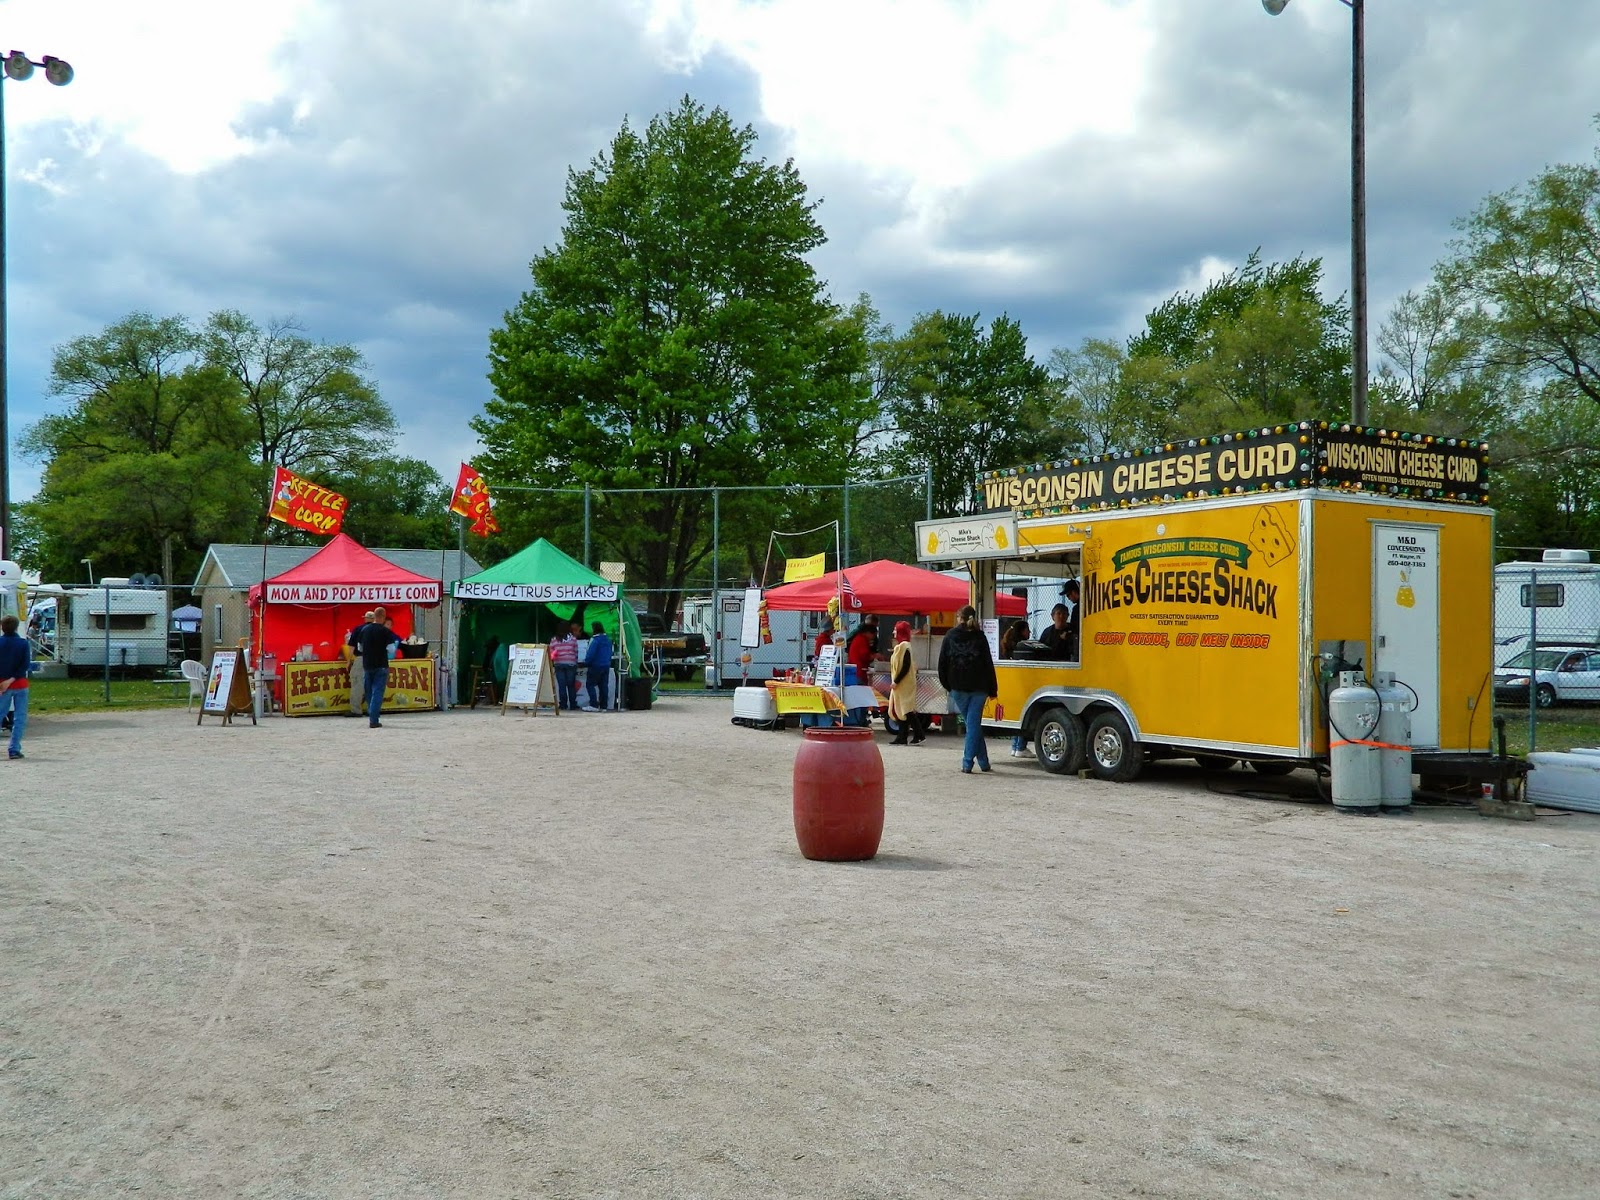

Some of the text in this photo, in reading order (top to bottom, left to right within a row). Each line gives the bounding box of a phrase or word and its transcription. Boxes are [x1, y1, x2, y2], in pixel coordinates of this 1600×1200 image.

[1407, 441, 1427, 449] Original
[1327, 442, 1477, 482] WISCONSIN CHEESE CURD
[985, 442, 1298, 509] WISCONSIN CHEESE CURD
[1415, 480, 1442, 488] DUPLICATED
[290, 475, 345, 511] KETTLE
[295, 506, 337, 530] CORN
[1397, 536, 1416, 544] M&D
[1120, 547, 1142, 564] FAMOUS
[1143, 541, 1185, 555] WISCONSIN
[1188, 541, 1218, 552] CHEESE
[1219, 545, 1240, 557] CURDS
[271, 586, 437, 600] MOM AND POP KETTLE CORN
[457, 583, 615, 599] FRESH CITRUS SHAKERS
[1083, 559, 1278, 619] MIKE'S CHEESE SHACK
[1149, 613, 1185, 621] SATISFACTION
[1094, 631, 1271, 650] CRISPY OUTSIDE, HOT MELT INSIDE
[387, 666, 428, 691] ORN
